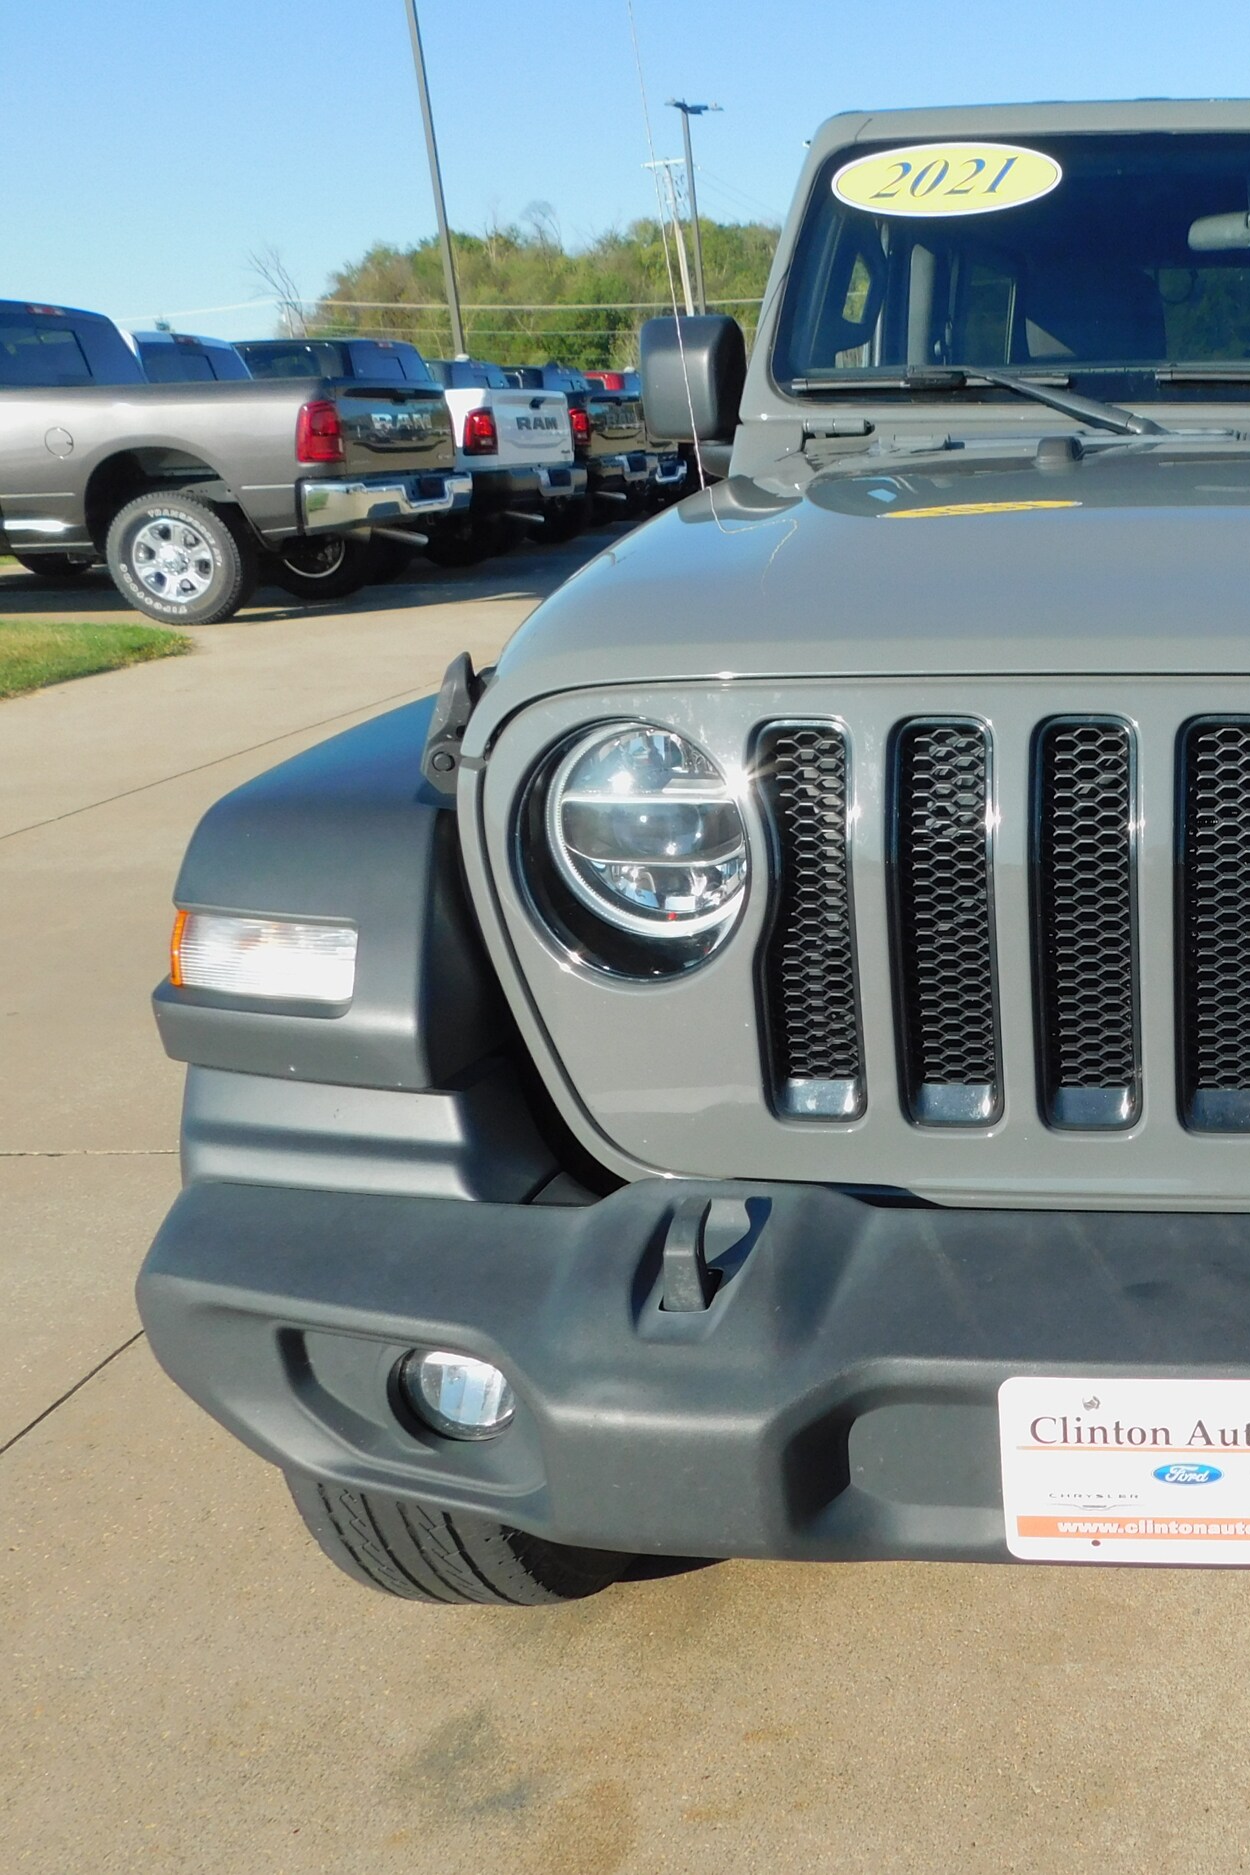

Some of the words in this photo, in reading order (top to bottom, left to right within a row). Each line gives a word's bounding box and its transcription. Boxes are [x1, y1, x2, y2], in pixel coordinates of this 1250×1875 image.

[868, 156, 1019, 199] 2021
[370, 412, 433, 431] RAM
[516, 416, 559, 430] RAM
[1030, 1416, 1173, 1447] Clinton
[1163, 1465, 1210, 1485] Ford
